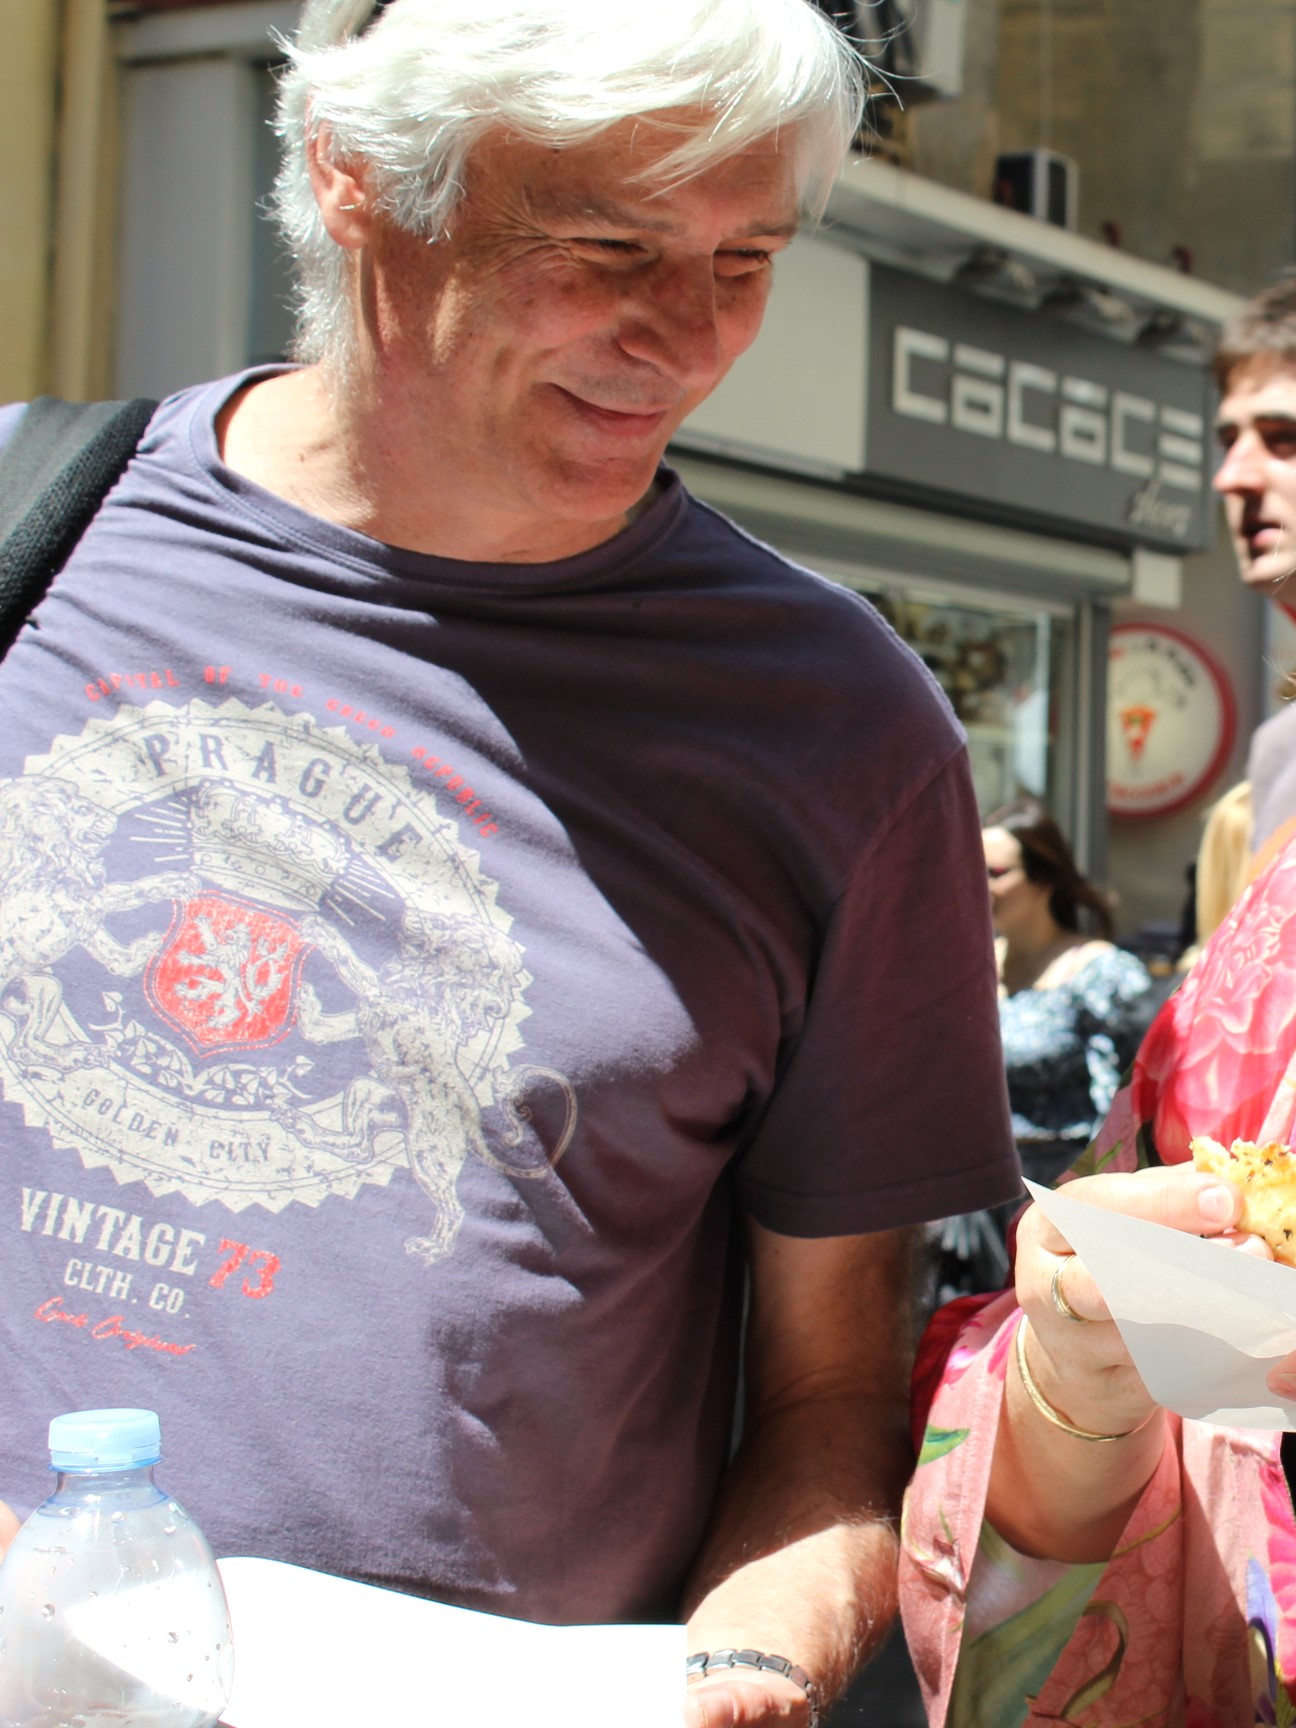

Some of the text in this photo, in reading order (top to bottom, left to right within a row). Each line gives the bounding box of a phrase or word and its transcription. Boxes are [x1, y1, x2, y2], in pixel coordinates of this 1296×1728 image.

[143, 732, 423, 863] PRAGUE
[83, 1087, 271, 1163] GOLDEN CITY
[20, 1187, 282, 1299] VINTAGE 73
[63, 1258, 190, 1319] CLTH. CO.
